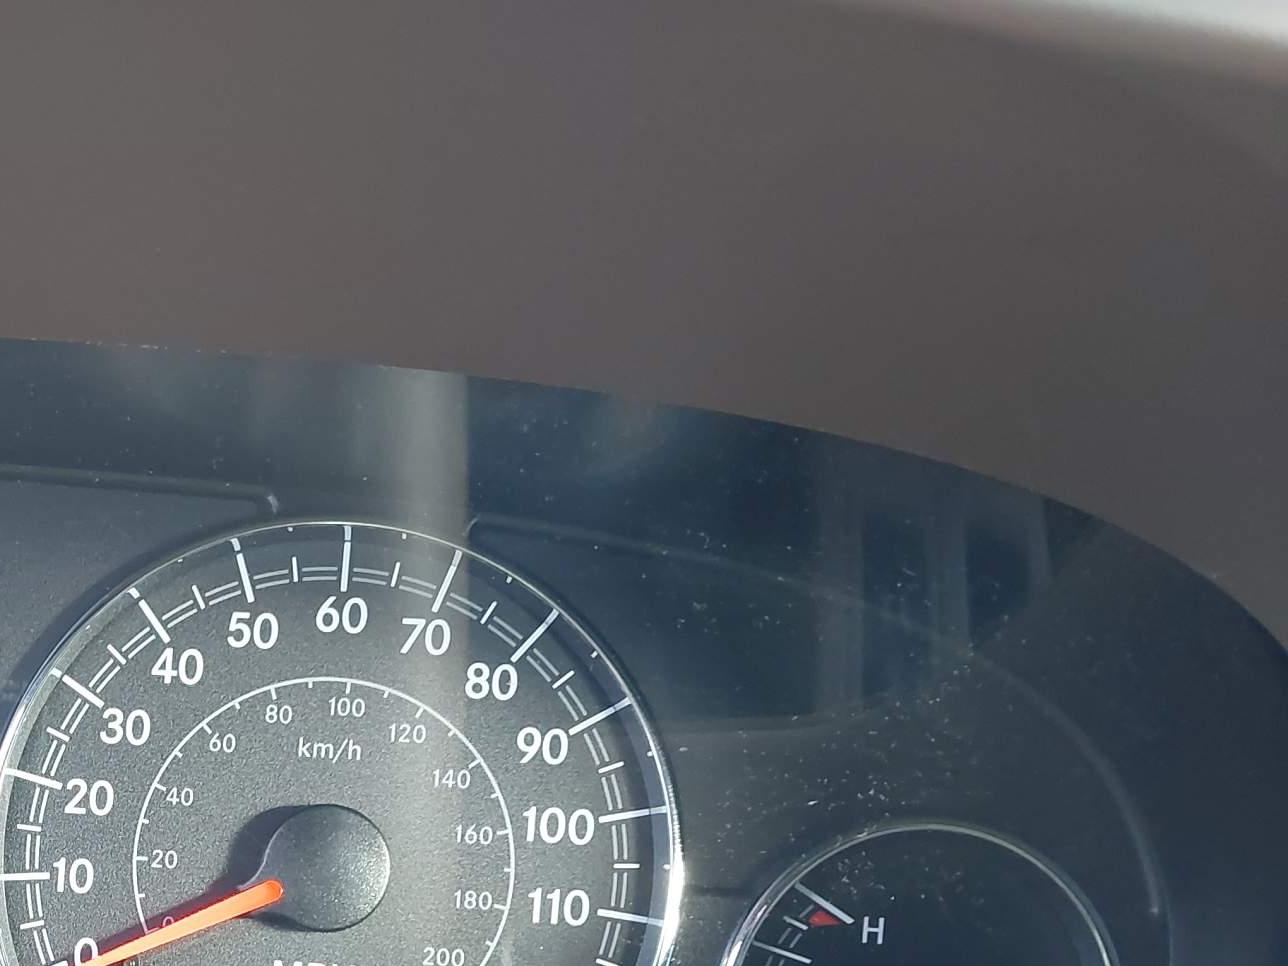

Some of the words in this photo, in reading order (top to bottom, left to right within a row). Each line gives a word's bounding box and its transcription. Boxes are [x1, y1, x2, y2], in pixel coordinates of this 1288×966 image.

[227, 612, 279, 649] 50
[316, 597, 368, 633] 60
[400, 618, 451, 655] 70
[151, 648, 204, 685] 40
[465, 663, 518, 700] 80
[265, 704, 293, 724] 80
[327, 696, 366, 717] 100
[100, 709, 150, 745] 30
[209, 733, 236, 753] 60
[388, 723, 427, 743] 120
[298, 736, 362, 764] km/h
[517, 727, 569, 765] 90
[432, 769, 471, 789] 140
[64, 779, 114, 816] 20
[166, 786, 194, 806] 40
[455, 825, 493, 845] 160
[522, 807, 595, 845] 100
[150, 850, 178, 869] 20
[53, 858, 94, 894] 10
[454, 890, 493, 910] 180
[527, 888, 590, 925] 110
[862, 917, 885, 945] H
